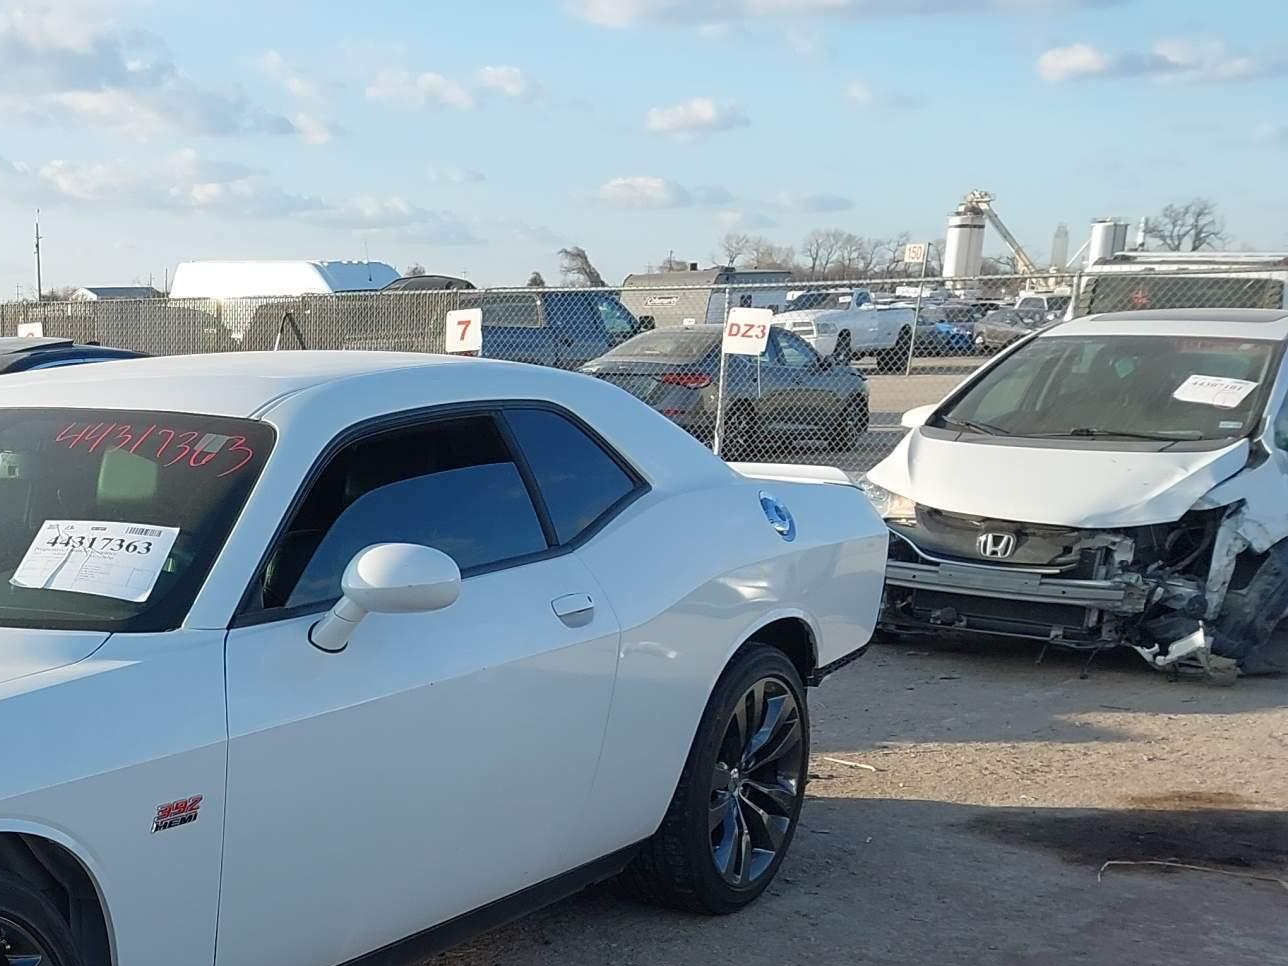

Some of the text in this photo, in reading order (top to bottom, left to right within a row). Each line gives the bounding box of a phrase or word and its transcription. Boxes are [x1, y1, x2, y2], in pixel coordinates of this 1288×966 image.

[457, 320, 472, 341] 7
[728, 323, 767, 340] DZ3
[47, 535, 153, 555] 44317363
[157, 794, 203, 820] 392
